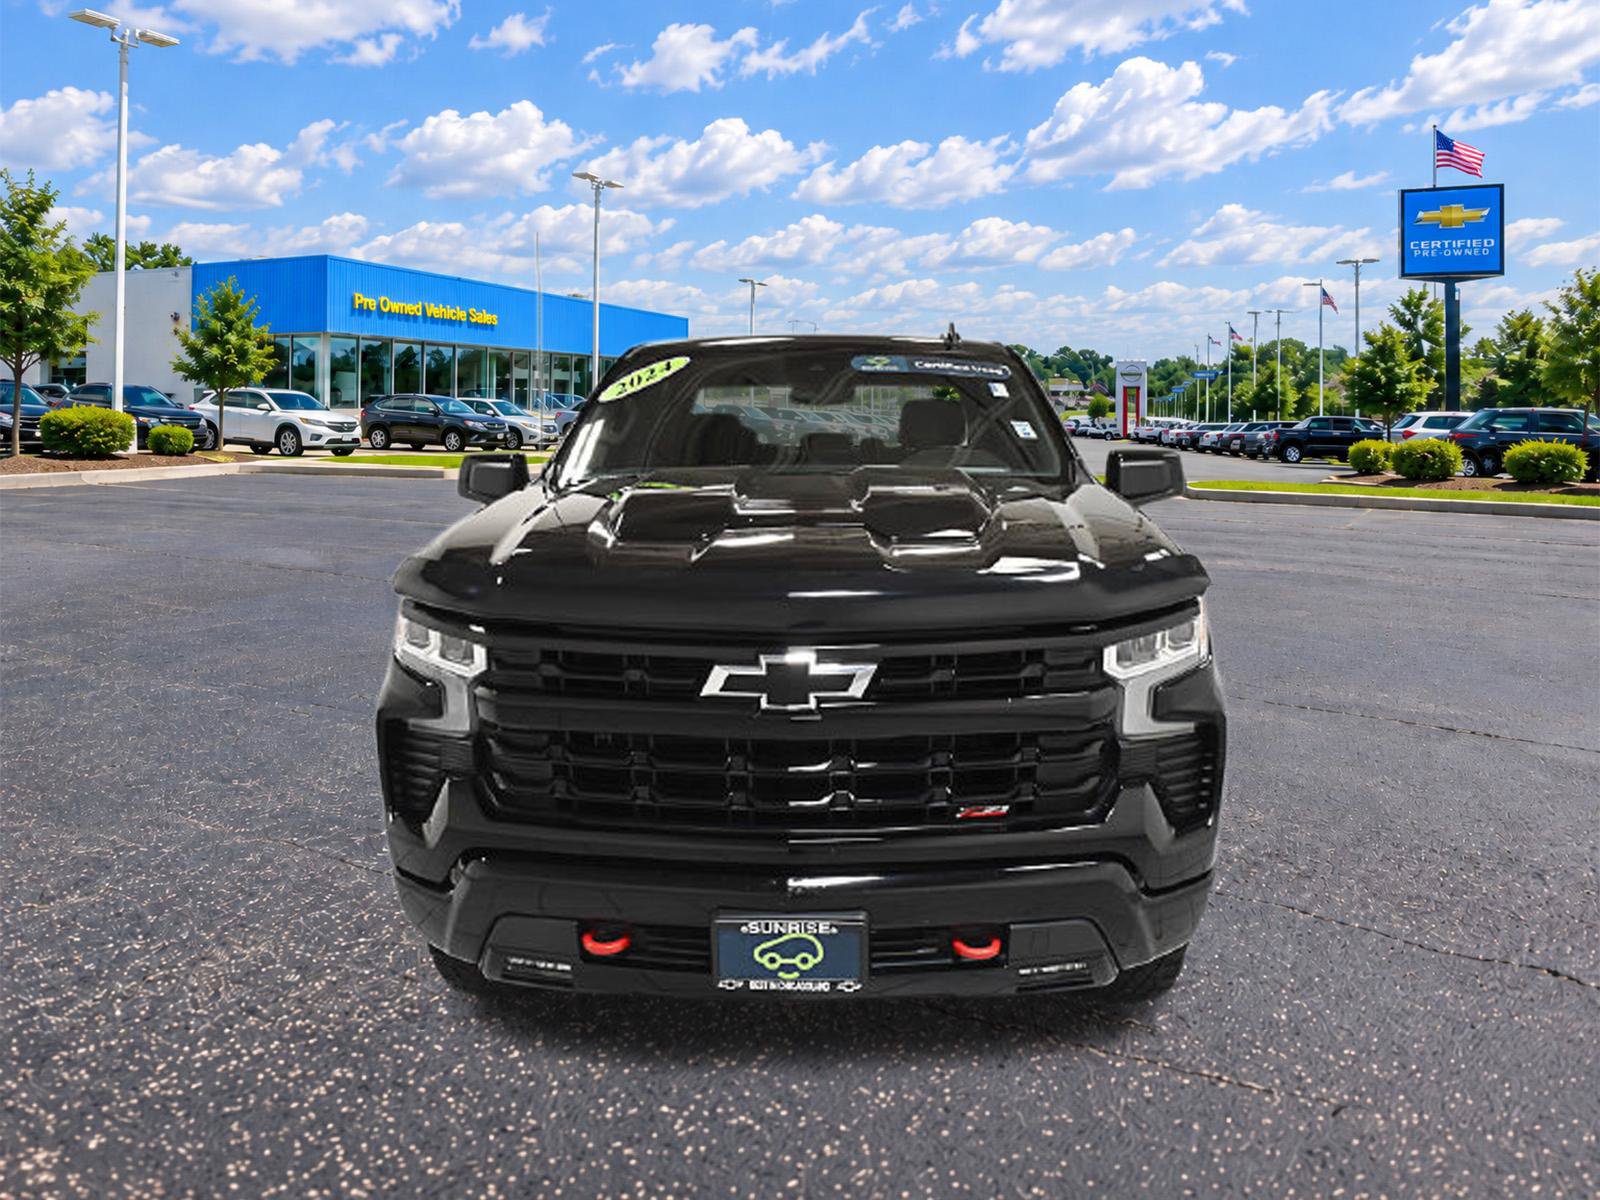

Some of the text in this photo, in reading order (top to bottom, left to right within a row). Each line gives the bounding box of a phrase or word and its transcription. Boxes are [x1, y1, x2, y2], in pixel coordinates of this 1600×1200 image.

[1410, 238, 1495, 250] CERTIFIED
[1414, 248, 1490, 257] PRE-OWNED
[353, 292, 498, 326] Pre Owned Vehicle Sales
[615, 361, 671, 396] 2024
[748, 921, 830, 935] SUNRISE
